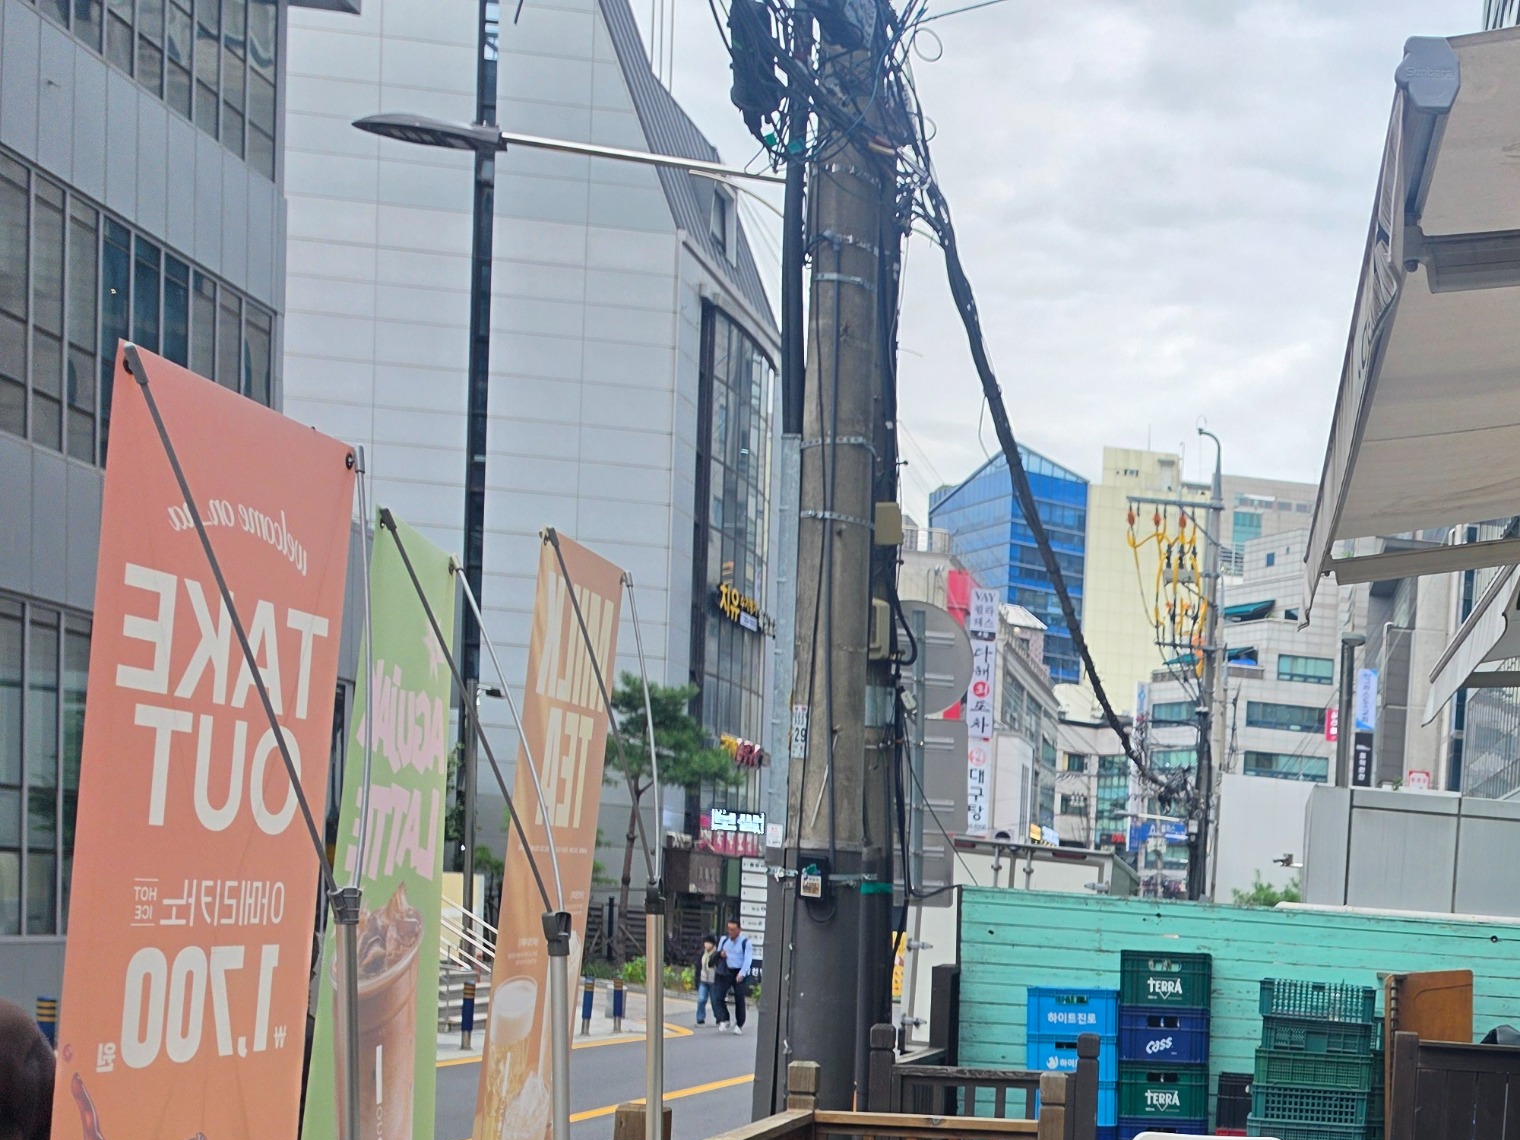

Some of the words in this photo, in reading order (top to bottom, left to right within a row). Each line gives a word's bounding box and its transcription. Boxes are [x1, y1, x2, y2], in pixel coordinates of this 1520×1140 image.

[1147, 976, 1183, 996] TERRA
[1047, 1011, 1097, 1025] 하이트진로
[1144, 1088, 1181, 1107] TERRA
